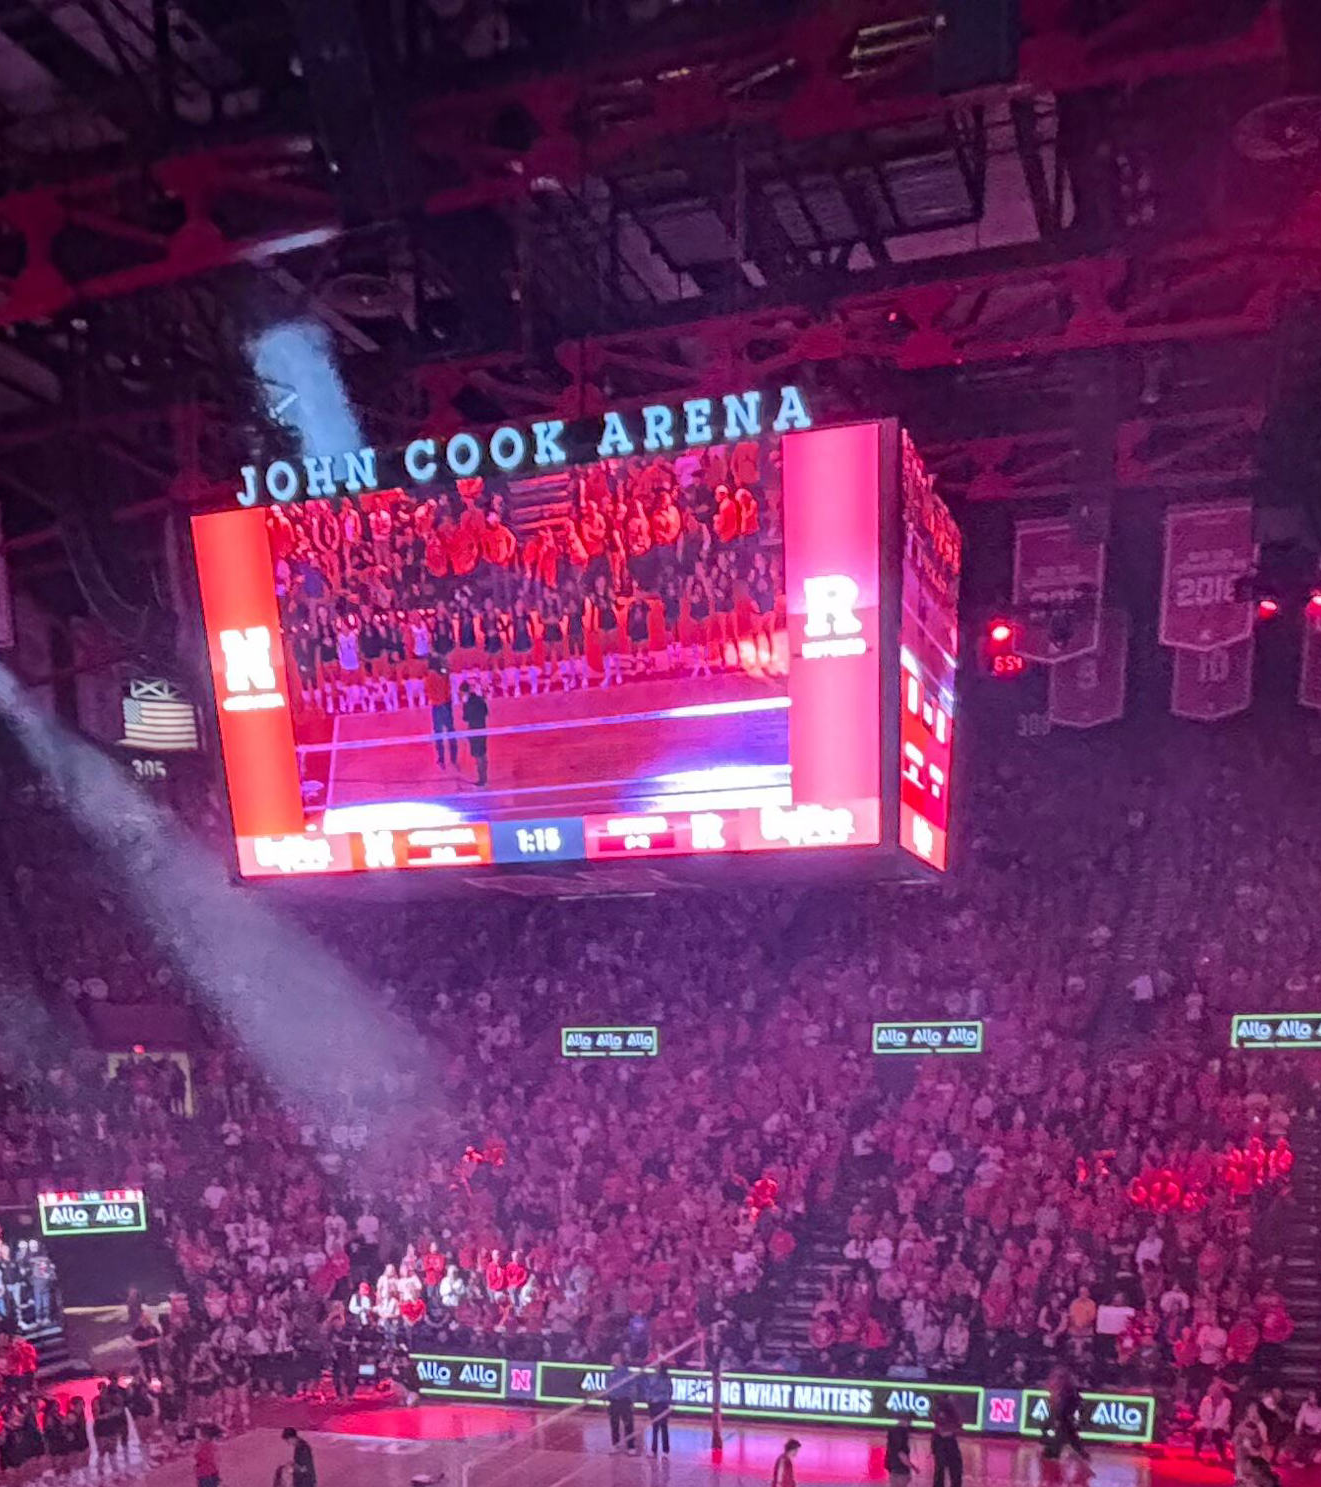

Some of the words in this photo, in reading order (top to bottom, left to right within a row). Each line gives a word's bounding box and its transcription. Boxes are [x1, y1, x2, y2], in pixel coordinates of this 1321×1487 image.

[236, 447, 378, 508] JOHN
[403, 419, 567, 482] COOK
[597, 385, 812, 458] ARENA
[803, 573, 863, 638] R
[220, 625, 276, 692] N
[131, 758, 167, 778] 305
[566, 1032, 592, 1047] Allo
[596, 1032, 622, 1047] Allo
[626, 1032, 653, 1047] Allo
[878, 1028, 907, 1045] Allo
[911, 1028, 942, 1045] Allo
[947, 1027, 977, 1044] Allo
[1237, 1020, 1271, 1038] Allo
[1276, 1019, 1312, 1038] Allo
[49, 1206, 89, 1225] Allo
[96, 1204, 135, 1223] Allo
[459, 1364, 497, 1384] Allo
[510, 1368, 532, 1392] N
[581, 1371, 606, 1392] All
[743, 1383, 792, 1409] WHAT
[793, 1386, 873, 1414] MATTERS
[886, 1390, 930, 1412] Allo
[989, 1397, 1016, 1423] N
[1090, 1402, 1142, 1426] Allo
